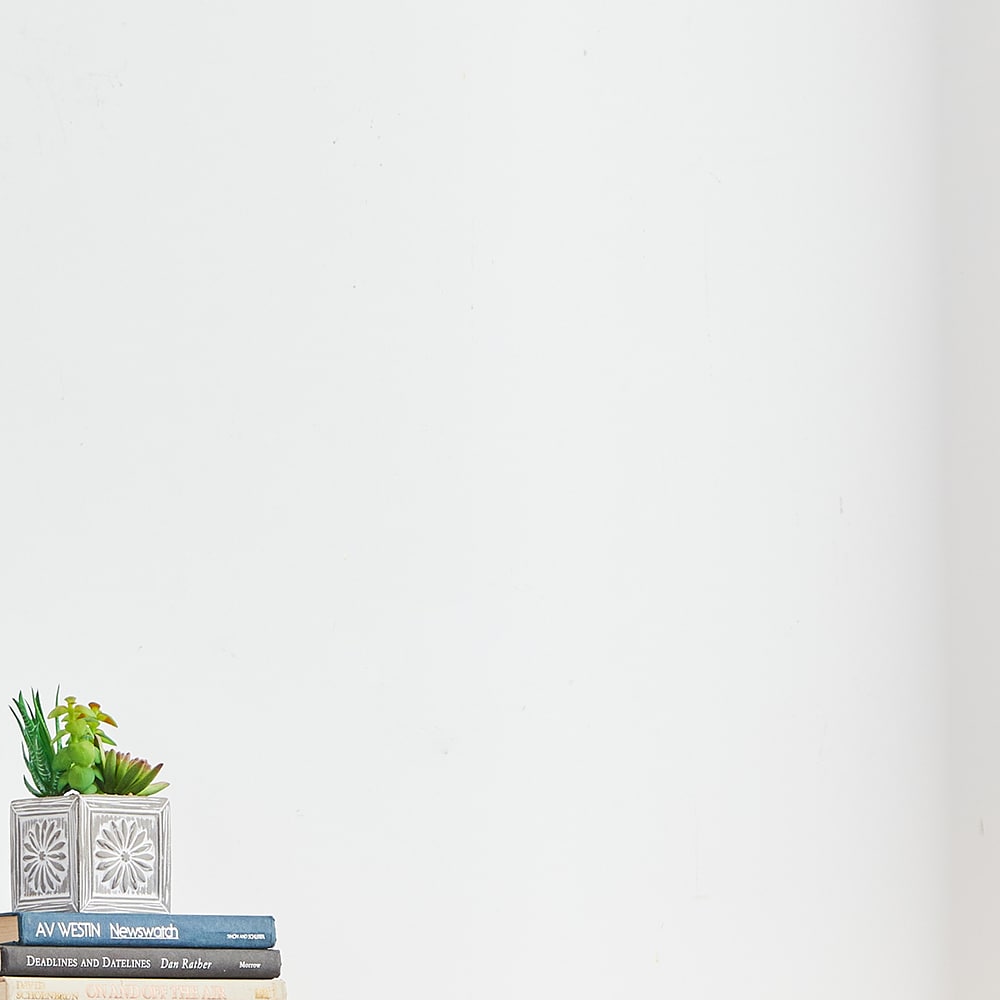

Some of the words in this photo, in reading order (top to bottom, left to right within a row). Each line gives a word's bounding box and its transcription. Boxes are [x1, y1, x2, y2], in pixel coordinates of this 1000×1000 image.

[35, 922, 55, 937] AV
[57, 922, 101, 938] WESTIN
[110, 923, 179, 939] Newswatch
[26, 955, 78, 967] DEADLINES
[80, 958, 100, 968] AND
[102, 956, 152, 969] DATELINES
[160, 958, 179, 969] Dan
[182, 957, 212, 969] Rather
[239, 961, 262, 969] Morrow
